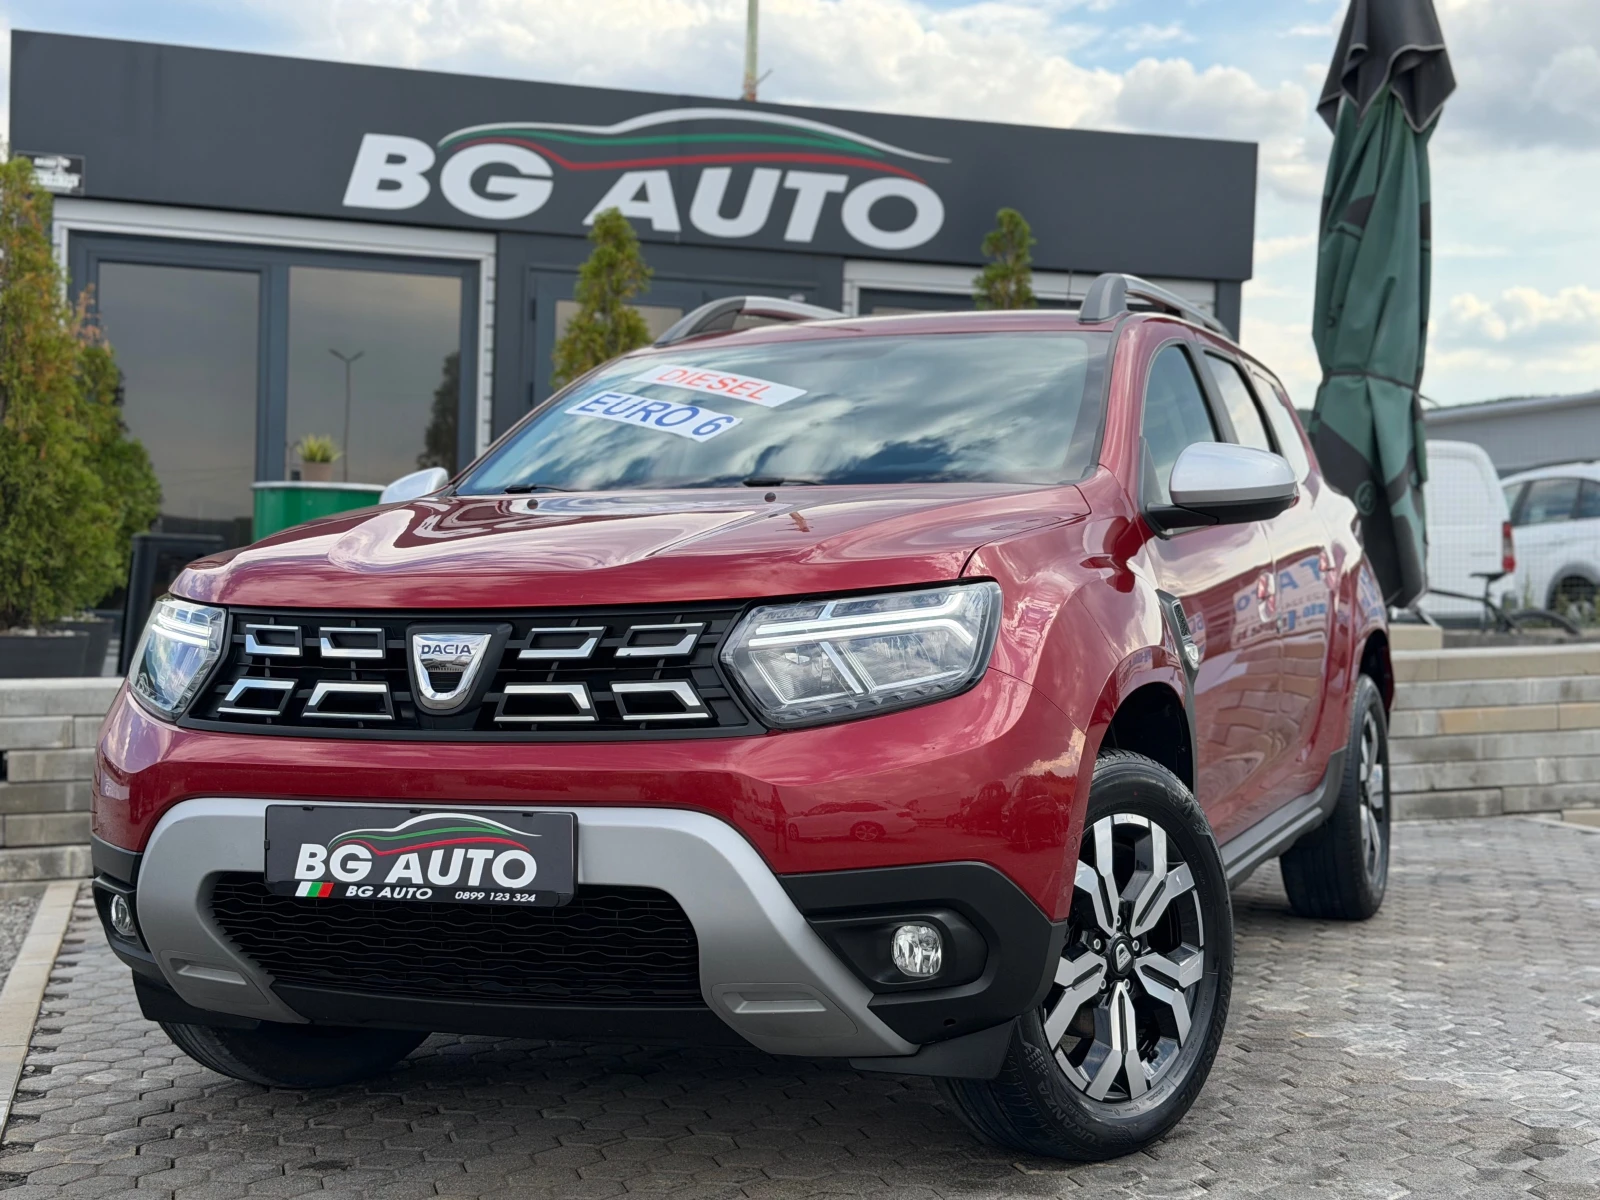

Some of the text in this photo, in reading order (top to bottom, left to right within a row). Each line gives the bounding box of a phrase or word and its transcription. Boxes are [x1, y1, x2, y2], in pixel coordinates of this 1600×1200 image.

[342, 133, 945, 251] BG AUTO
[657, 368, 773, 401] DIESEL
[577, 392, 735, 437] EURO 6
[421, 644, 472, 655] DACIA
[294, 843, 538, 889] BG AUTO
[345, 885, 433, 900] BG AUTO
[454, 890, 536, 903] 0899 123 324
[1037, 1080, 1103, 1147] URANZA
